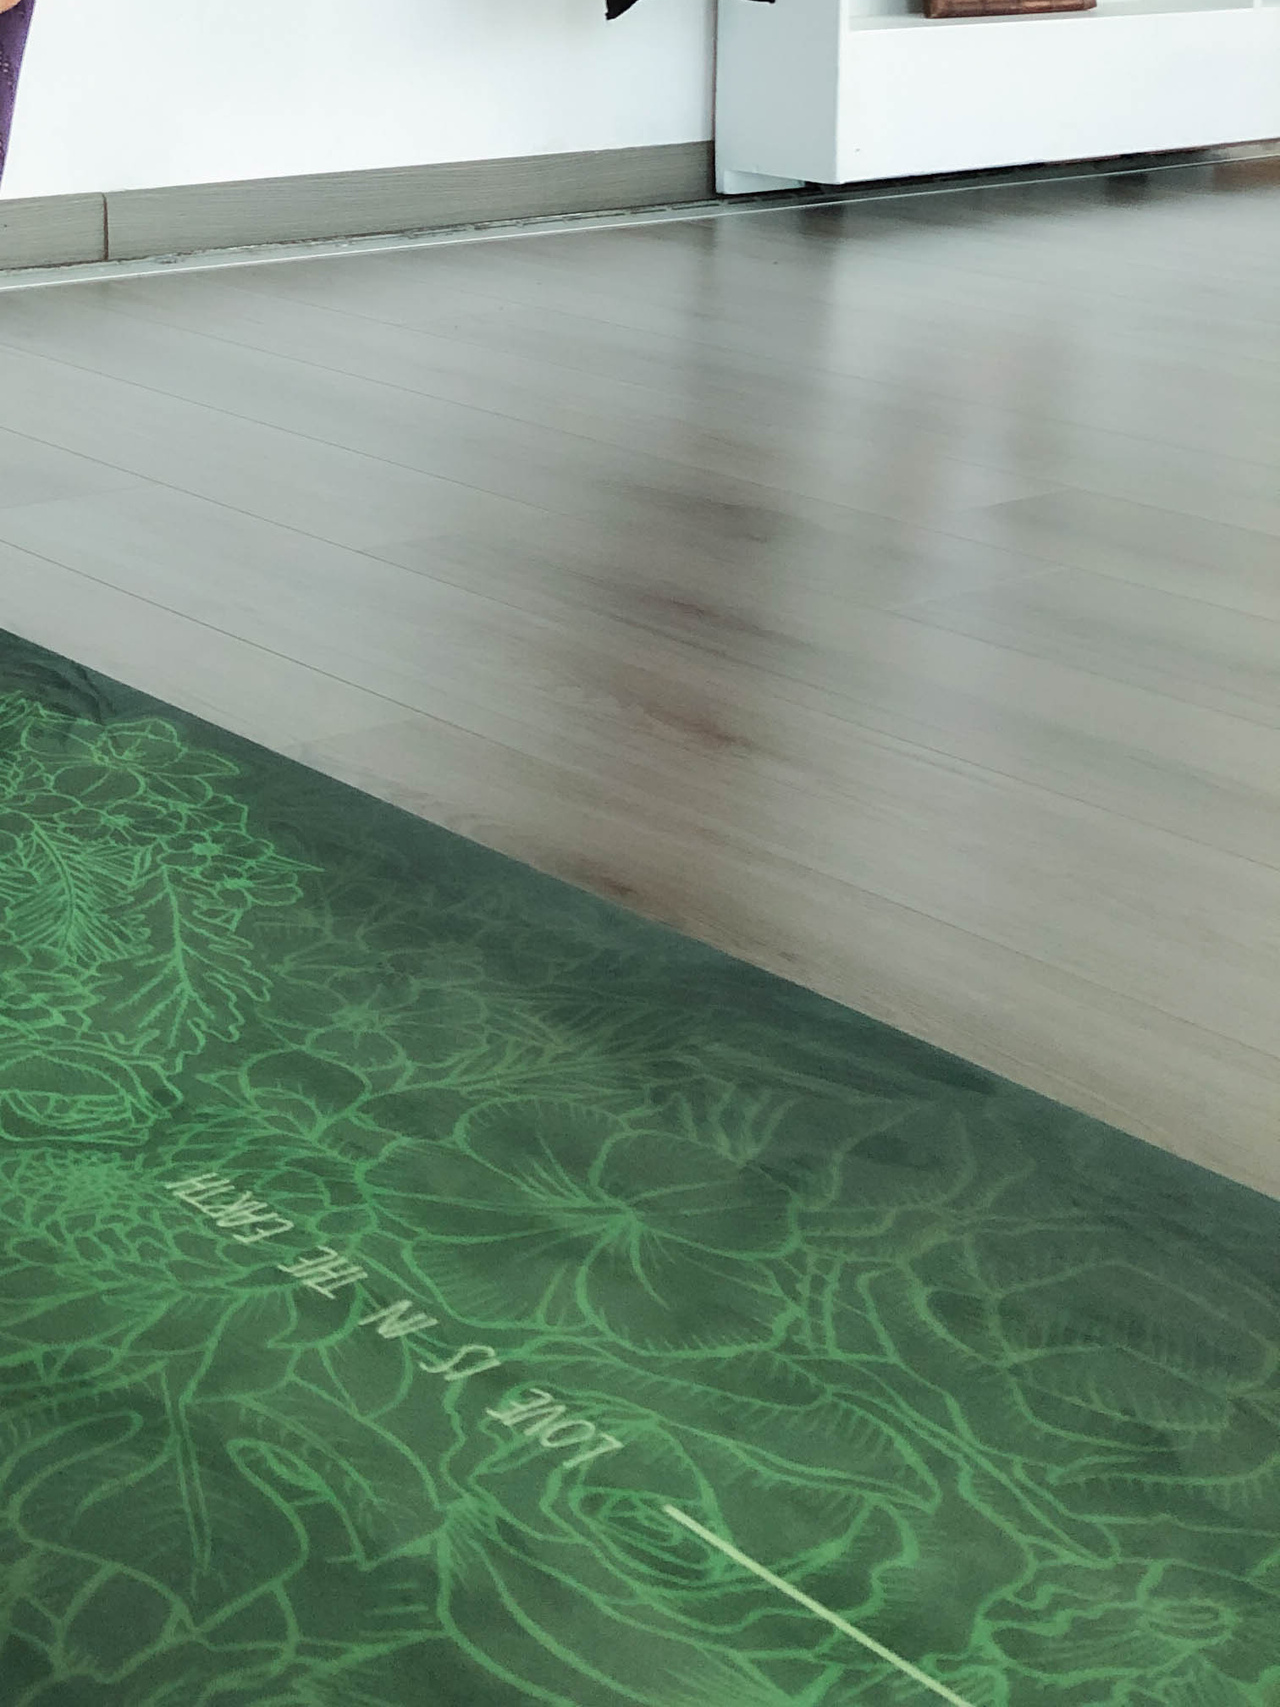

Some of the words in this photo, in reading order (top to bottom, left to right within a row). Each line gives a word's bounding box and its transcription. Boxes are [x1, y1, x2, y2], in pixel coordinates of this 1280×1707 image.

[165, 1171, 295, 1244] EARTH
[276, 1244, 369, 1299] THE
[357, 1298, 439, 1339] IN
[418, 1344, 502, 1382] IS
[485, 1387, 625, 1469] LOVE
